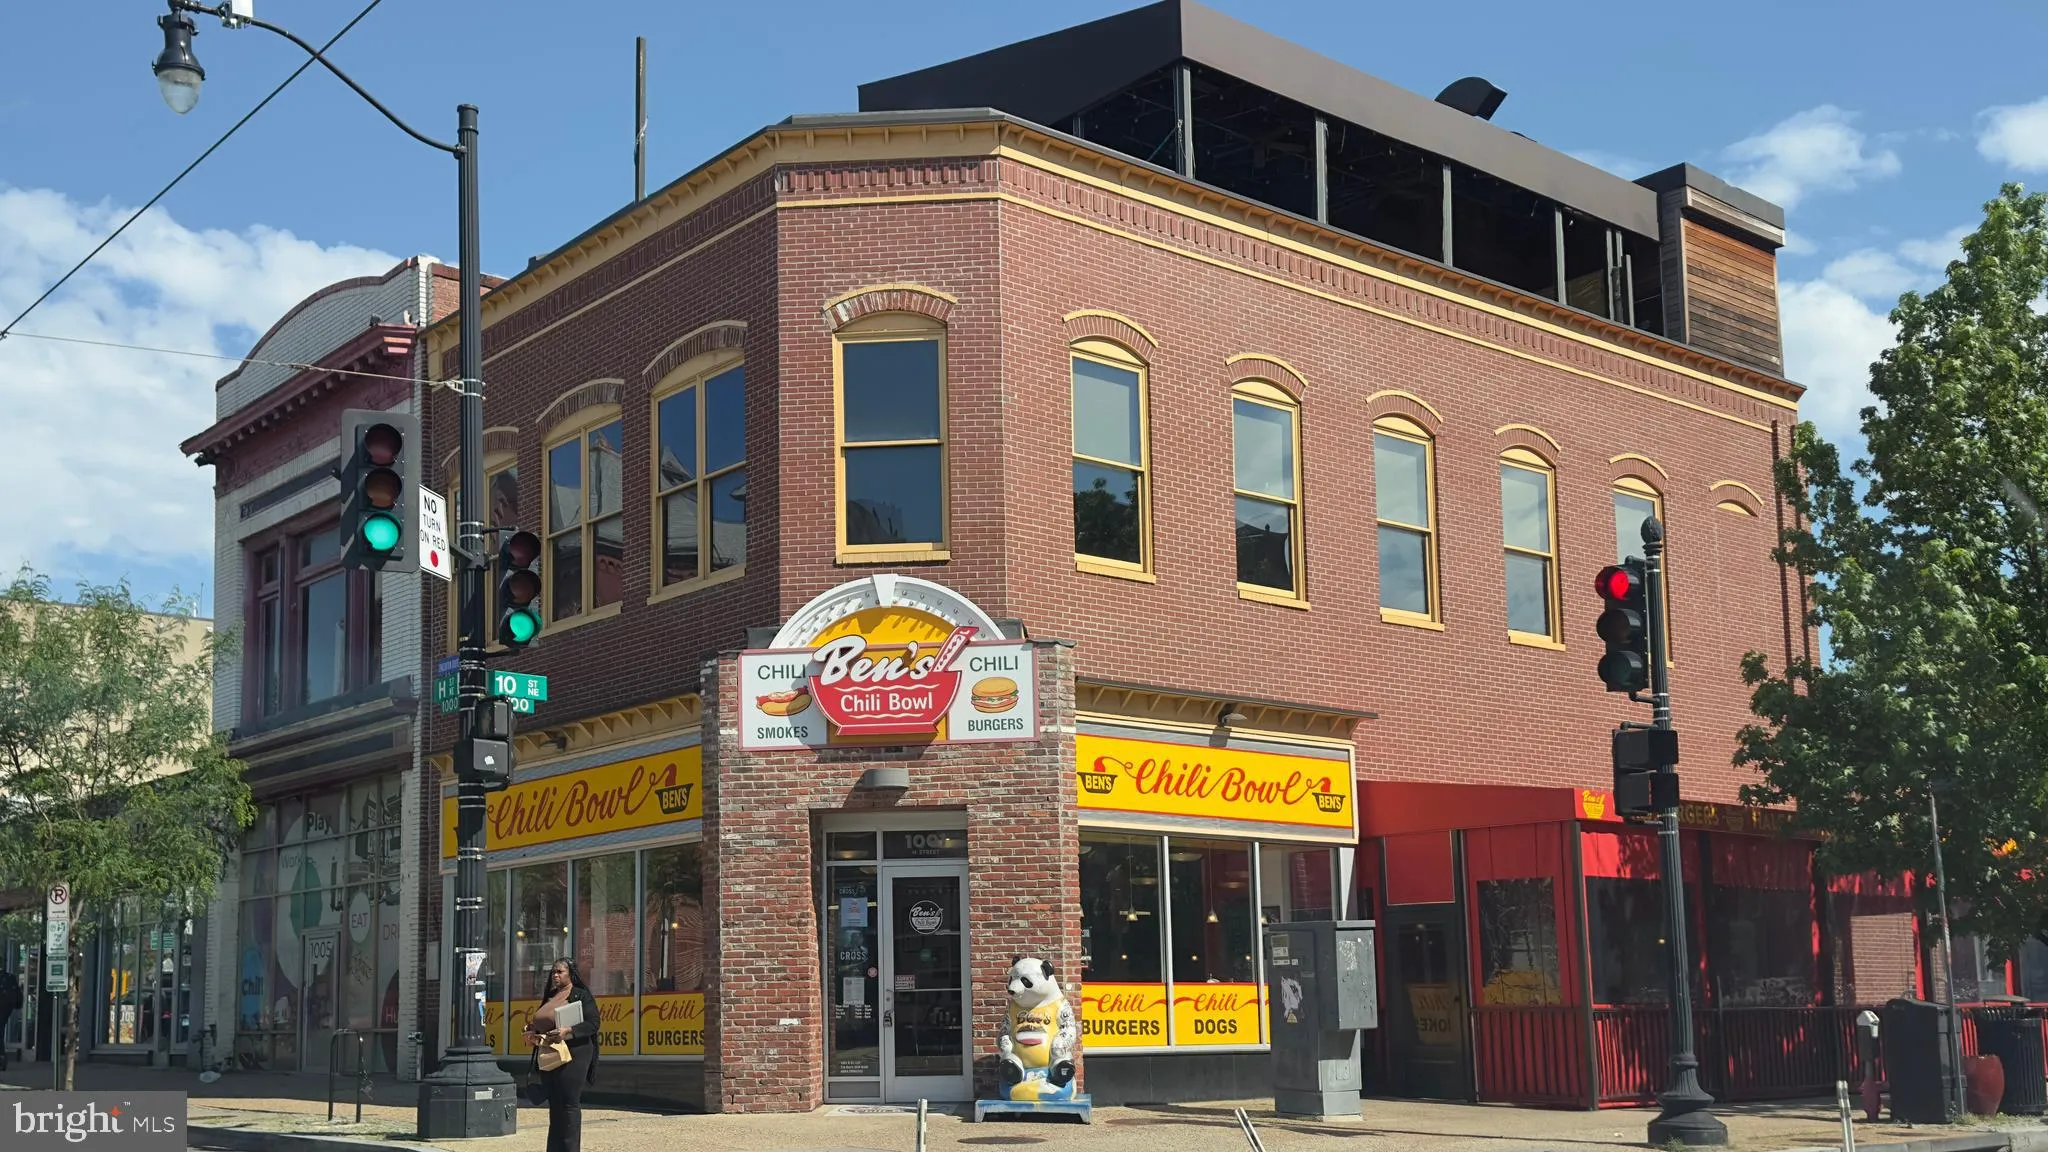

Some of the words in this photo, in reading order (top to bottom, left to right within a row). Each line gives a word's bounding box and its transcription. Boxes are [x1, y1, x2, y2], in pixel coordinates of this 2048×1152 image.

[424, 495, 437, 514] NO
[422, 514, 441, 532] TURN
[420, 529, 430, 544] ON
[432, 535, 446, 551] RED
[813, 635, 938, 686] Ben's
[969, 655, 1019, 672] CHILI
[757, 664, 806, 680] CHILI
[438, 681, 446, 699] H
[495, 676, 517, 694] 10
[527, 679, 539, 688] ST
[527, 688, 540, 697] NE
[442, 697, 459, 712] 1000
[507, 697, 529, 711] 00
[840, 694, 881, 713] Chili
[889, 692, 933, 711] Bowl
[757, 726, 809, 740] SMOKES
[967, 717, 1024, 732] BURGERS
[1085, 774, 1112, 790] BEN'S
[1133, 758, 1210, 799] Chili
[1219, 767, 1303, 806] Bowl
[490, 786, 559, 840] Chili
[565, 765, 652, 827] Bowl
[661, 787, 688, 809] BEN'S
[1318, 794, 1342, 810] BEN'S
[306, 811, 332, 834] Play
[911, 906, 936, 917] Ben's
[351, 912, 368, 929] EAT
[310, 941, 332, 958] 1005
[840, 951, 867, 960] CROSS
[659, 999, 697, 1021] Chili
[1097, 993, 1146, 1013] Chili
[1194, 993, 1241, 1012] Chili
[1081, 1019, 1160, 1036] BURGERS
[1194, 1018, 1238, 1035] DOGS
[598, 1031, 628, 1046] OKES
[647, 1030, 705, 1046] BURGERS
